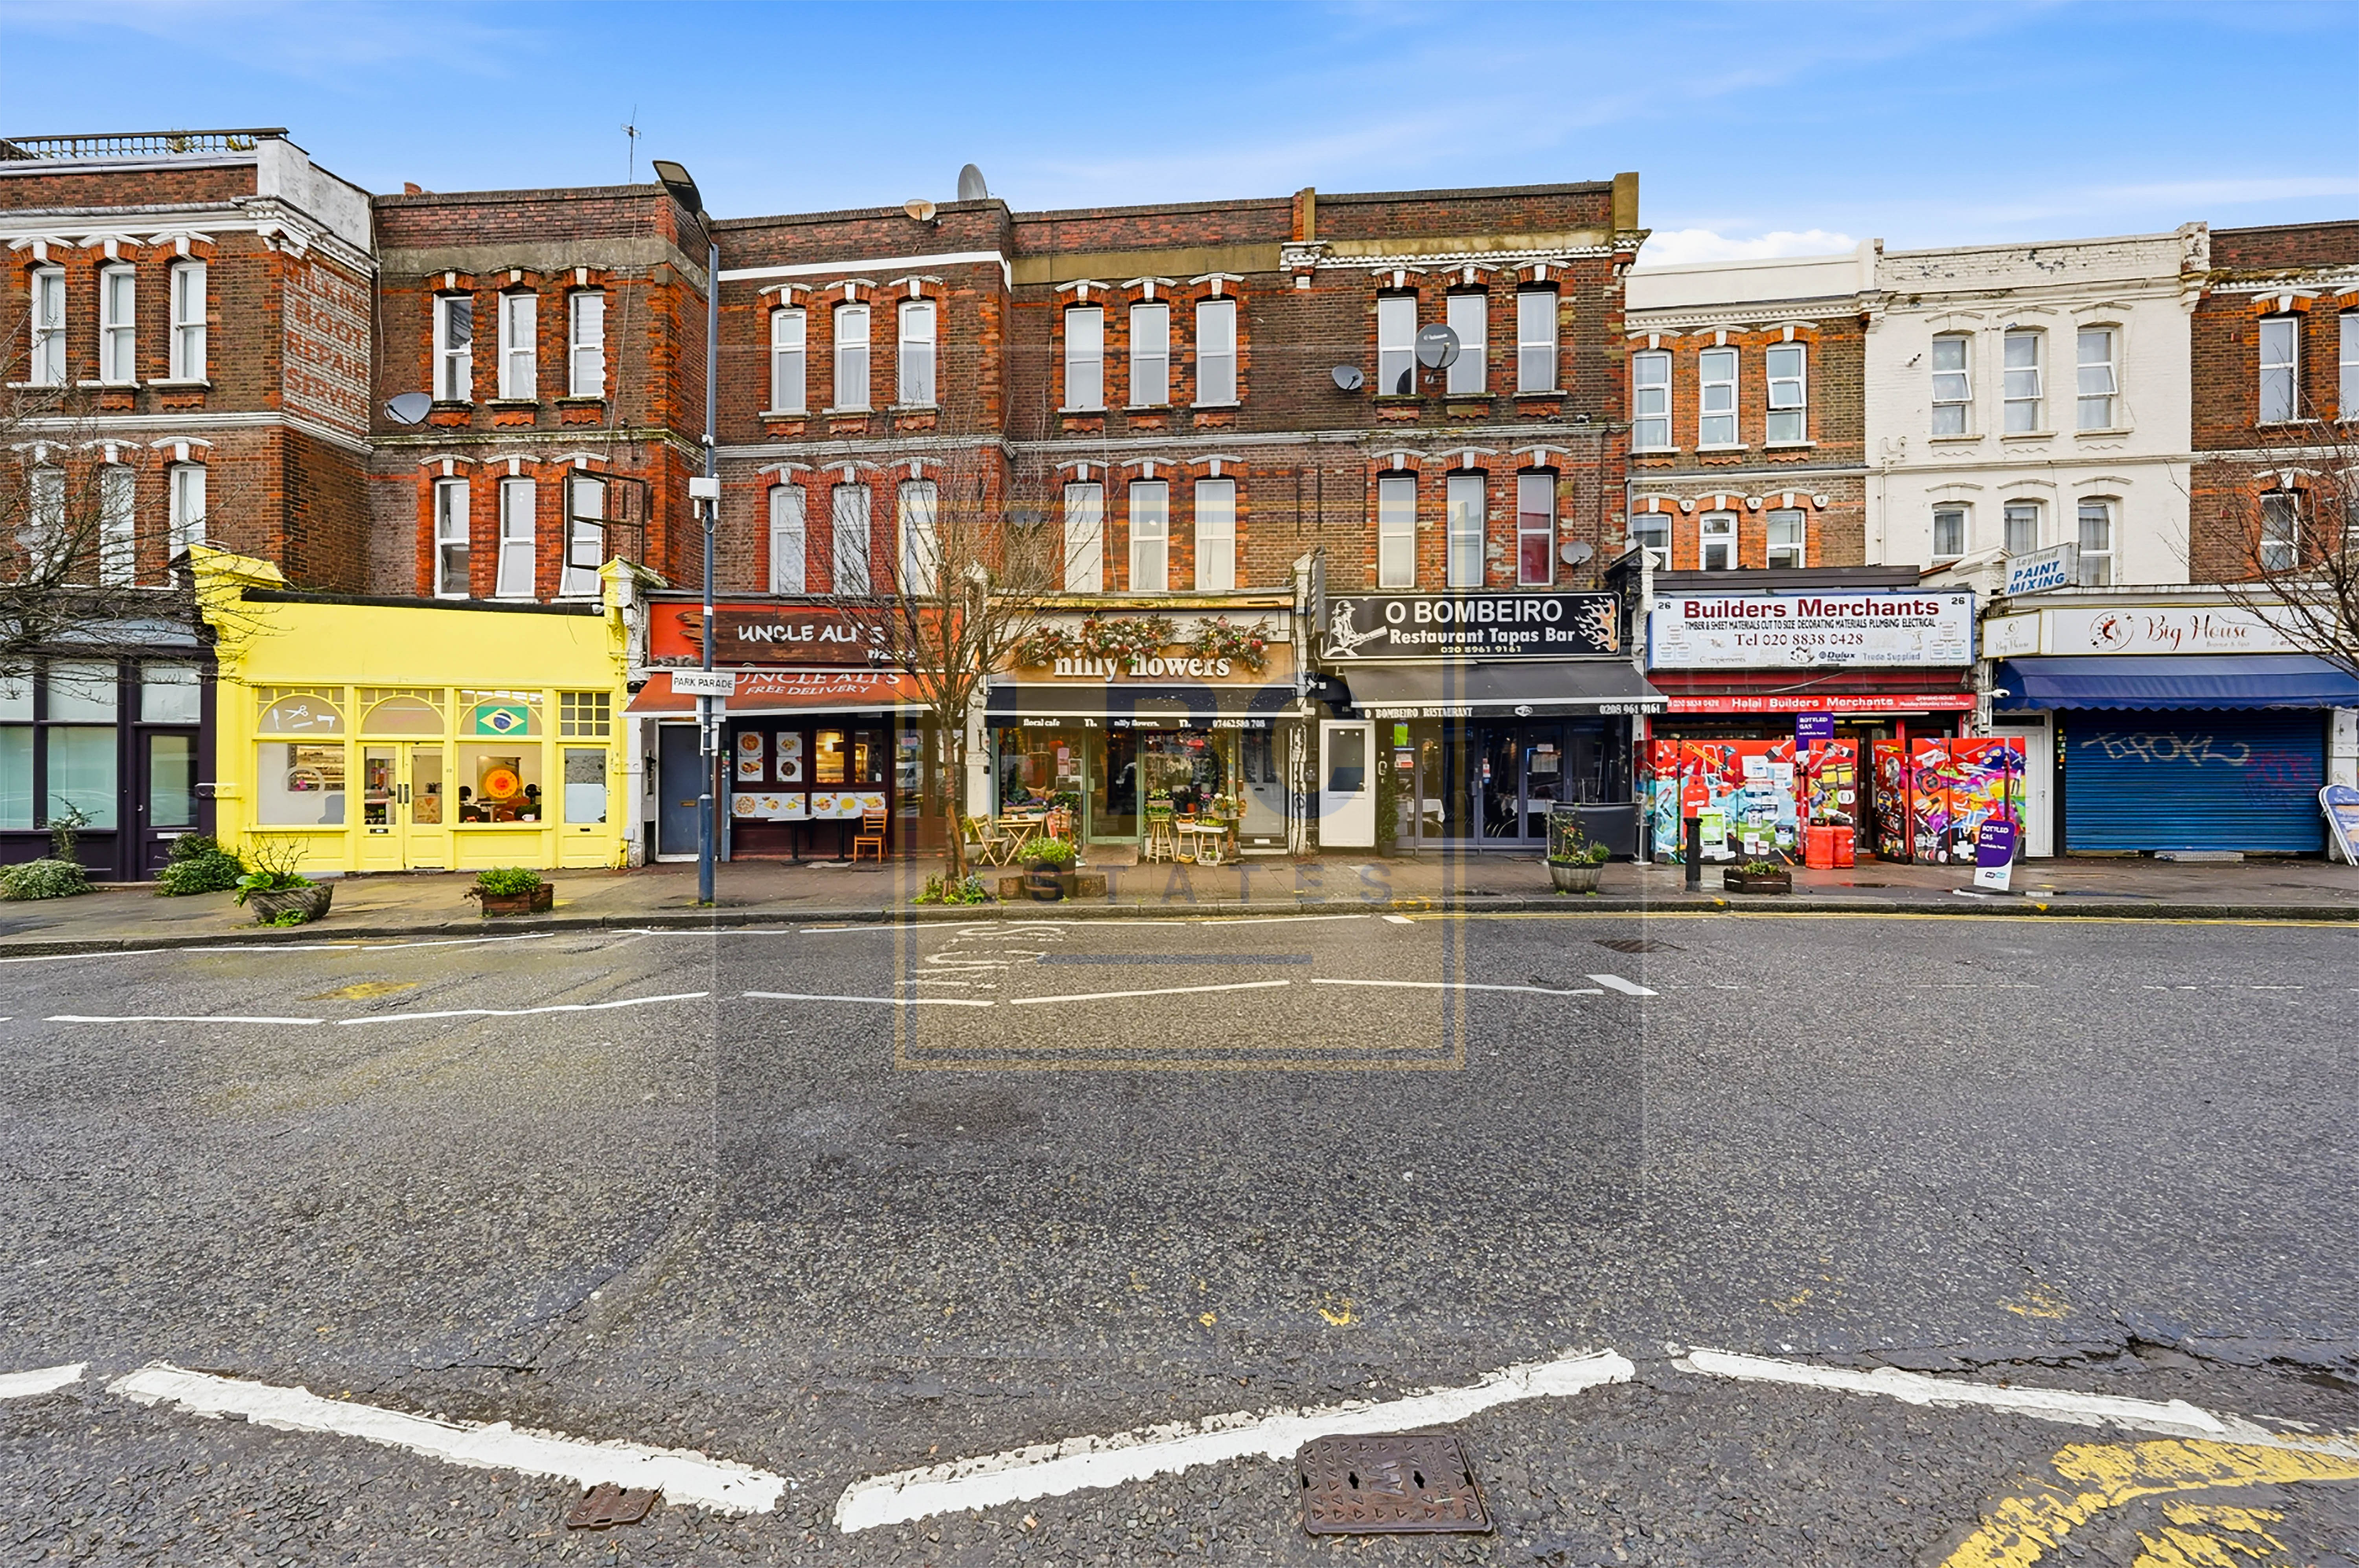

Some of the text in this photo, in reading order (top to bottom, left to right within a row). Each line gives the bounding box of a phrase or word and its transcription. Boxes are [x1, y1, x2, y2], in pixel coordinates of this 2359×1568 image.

[2017, 549, 2058, 566] Leyland
[2014, 560, 2060, 581] PAINT
[2008, 573, 2065, 594] MIXING
[1385, 599, 1563, 623] O BOMBEIRO
[1684, 598, 1939, 618] Builders Merchants
[1730, 620, 1759, 629] MATERIALS
[1774, 620, 1782, 629] TO
[1798, 619, 1834, 629] DECORATING
[1836, 619, 1867, 628] MATERIALS
[1902, 618, 1936, 628] ELECTRICAL
[738, 622, 885, 643] UNCLE ALI'S
[1390, 627, 1575, 644] Restaurant Tapas Bar
[1734, 634, 1863, 645] Tel 020 8838 0428
[2142, 614, 2250, 651] Big House
[1130, 651, 1230, 677] flowers
[674, 678, 732, 688] PARK PARADE
[745, 685, 870, 695] FREE DELIVERY
[1599, 704, 1660, 714] 0208 961 9161
[1769, 698, 1819, 707] Builders
[1827, 697, 1893, 706] Merchants
[1365, 707, 1473, 718] O BOMBEIRO RESTAURANT
[1982, 825, 2009, 833] BOTTLED
